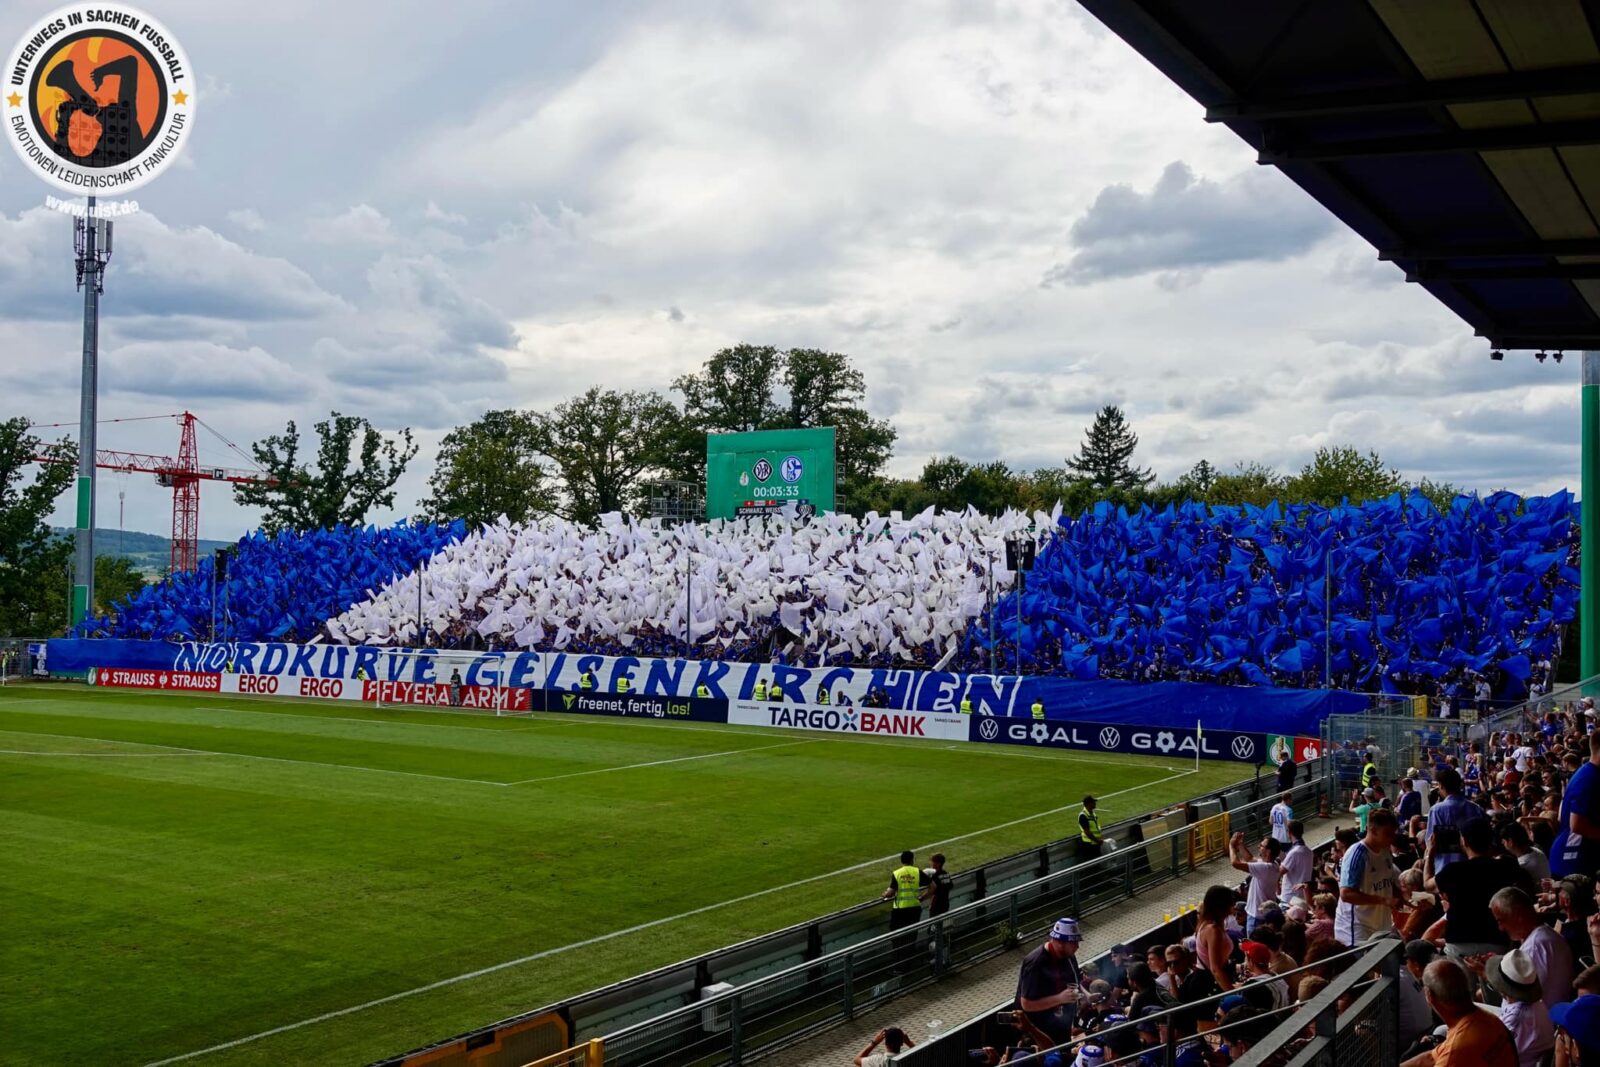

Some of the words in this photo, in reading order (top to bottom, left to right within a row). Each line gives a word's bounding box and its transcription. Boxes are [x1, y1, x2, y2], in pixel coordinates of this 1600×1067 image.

[753, 485, 799, 497] 00:03:33
[112, 671, 155, 687] STRAUSS
[171, 674, 217, 689] STRAUSS
[174, 640, 438, 684] NORDKURVE
[465, 651, 1023, 718] GELSENKIRCHEN
[239, 674, 279, 693] ERGO
[300, 677, 343, 697] ERGO
[381, 681, 509, 709] FLYERAARM
[578, 696, 626, 715] freenet,
[627, 699, 665, 718] fertig,
[667, 701, 690, 715] los!
[1273, 811, 1284, 825] 10
